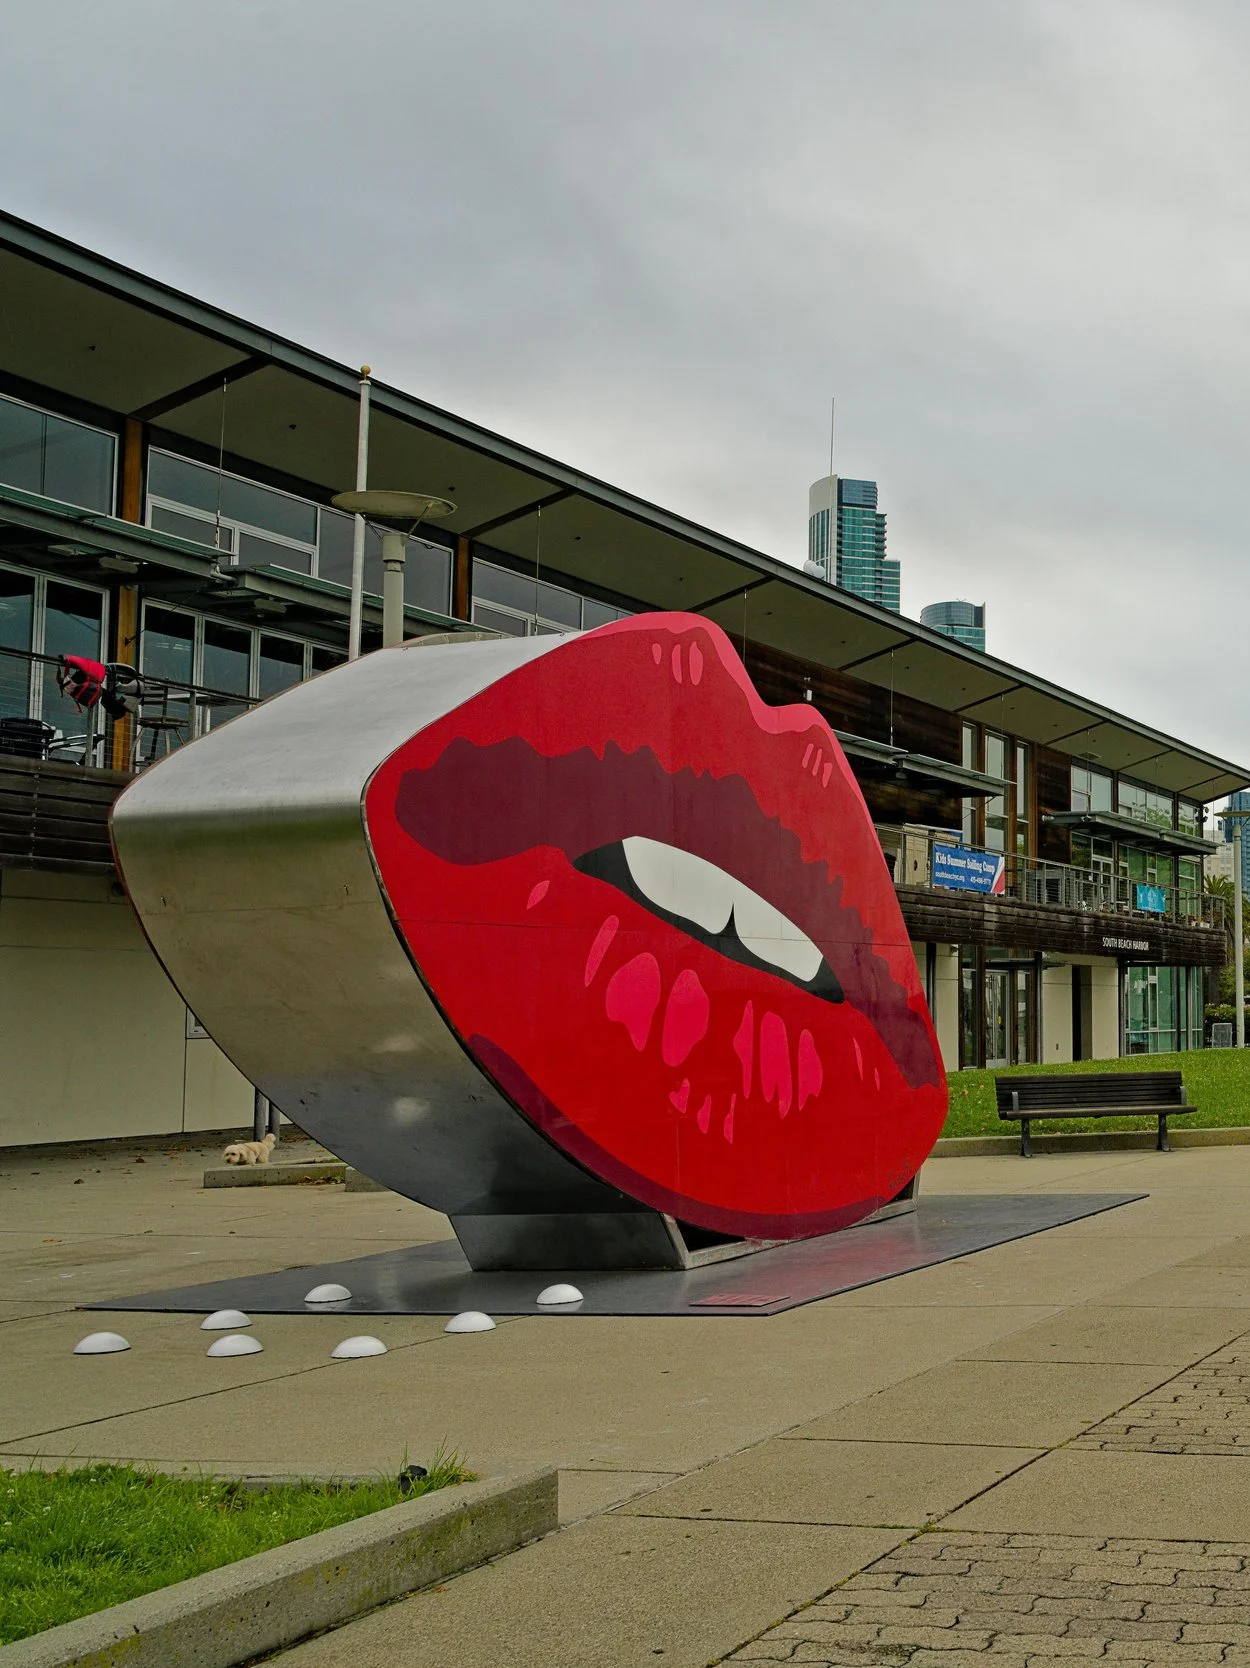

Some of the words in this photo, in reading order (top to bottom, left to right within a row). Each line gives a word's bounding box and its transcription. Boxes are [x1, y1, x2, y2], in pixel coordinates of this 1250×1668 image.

[936, 853, 946, 864] Kids
[947, 854, 966, 867] Summer
[966, 858, 982, 873] Sailing
[983, 861, 995, 875] Camp
[1103, 937, 1117, 947] SOUTH
[1118, 939, 1132, 949] BEACH
[1133, 941, 1149, 950] HARBOR
